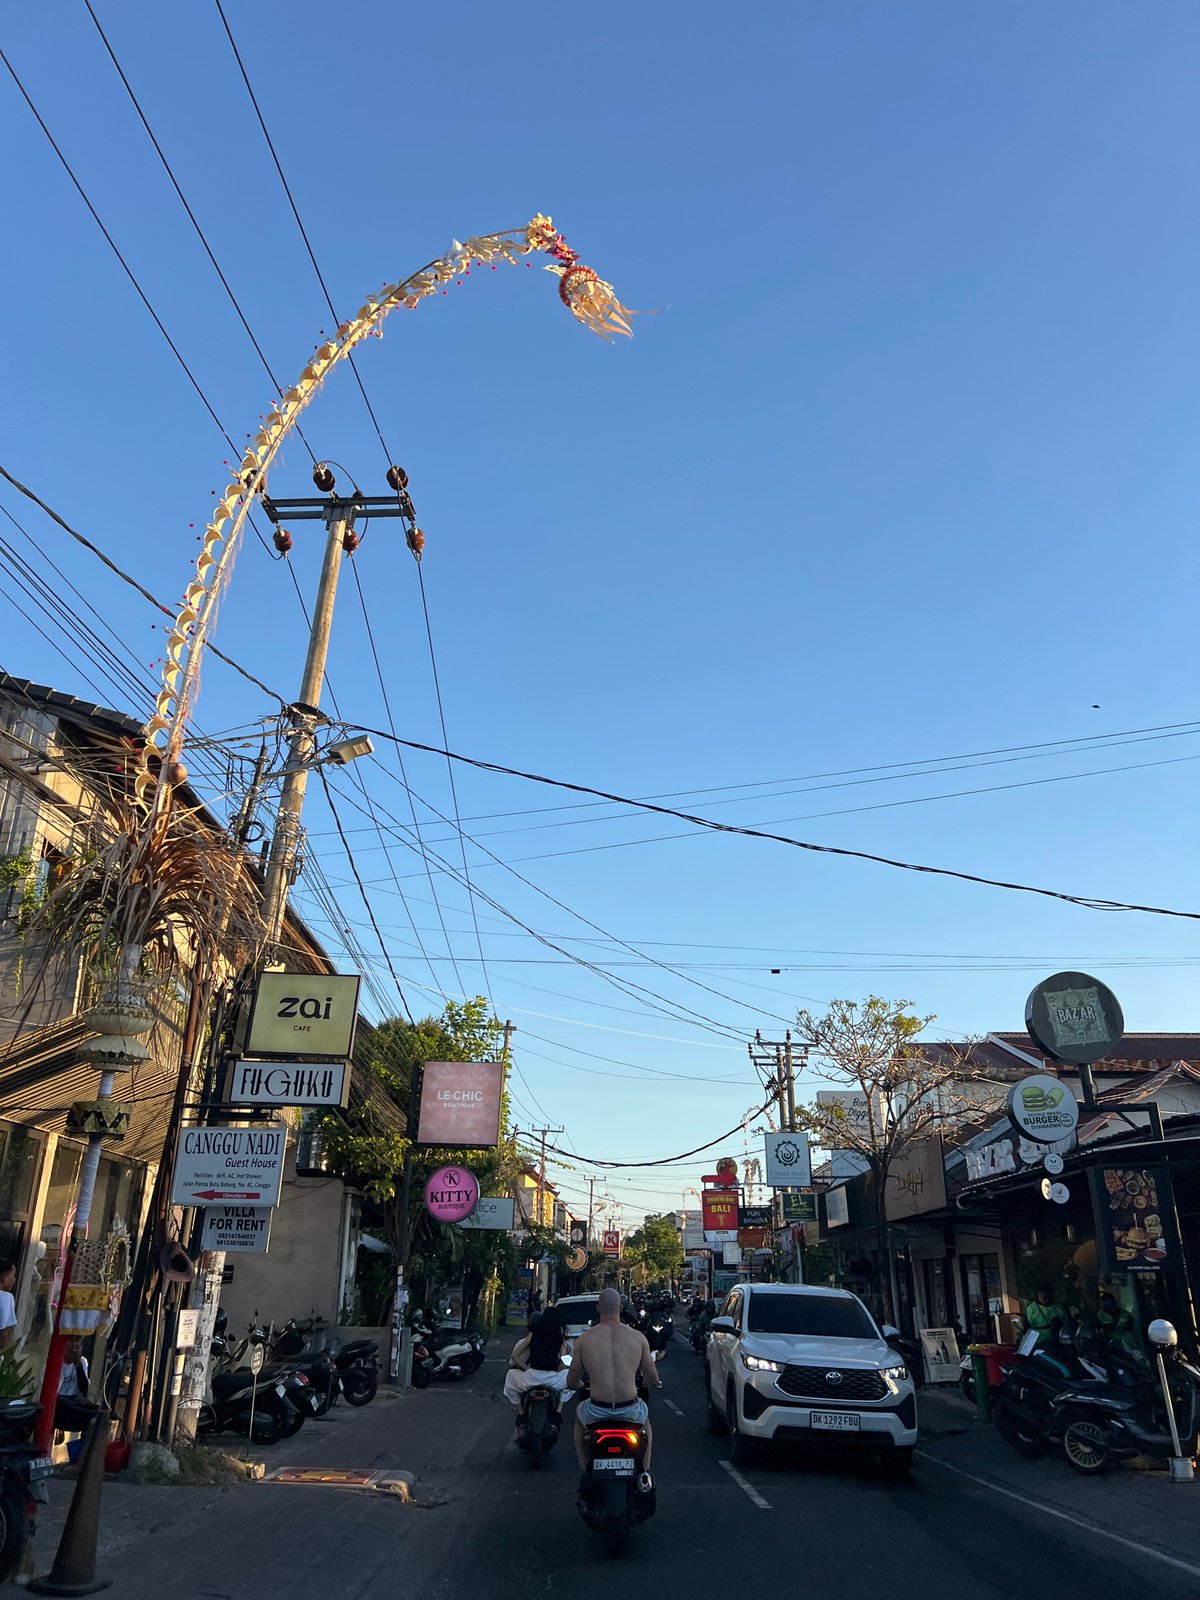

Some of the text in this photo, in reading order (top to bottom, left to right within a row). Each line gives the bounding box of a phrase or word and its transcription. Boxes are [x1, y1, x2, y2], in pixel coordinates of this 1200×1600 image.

[277, 997, 333, 1020] zai
[1057, 1006, 1096, 1023] BAZ'AR
[240, 1068, 333, 1098] FUGUKU
[437, 1090, 484, 1101] LE CHIC
[1023, 1115, 1060, 1126] BURGER
[184, 1132, 281, 1156] CANGGU NADI
[225, 1157, 277, 1168] Guest House
[430, 1190, 473, 1203] KITTY
[224, 1206, 256, 1218] VILLA
[711, 1204, 731, 1213] BALI
[209, 1218, 266, 1232] FOR RENT
[813, 1414, 823, 1424] DK
[823, 1415, 843, 1425] 1292
